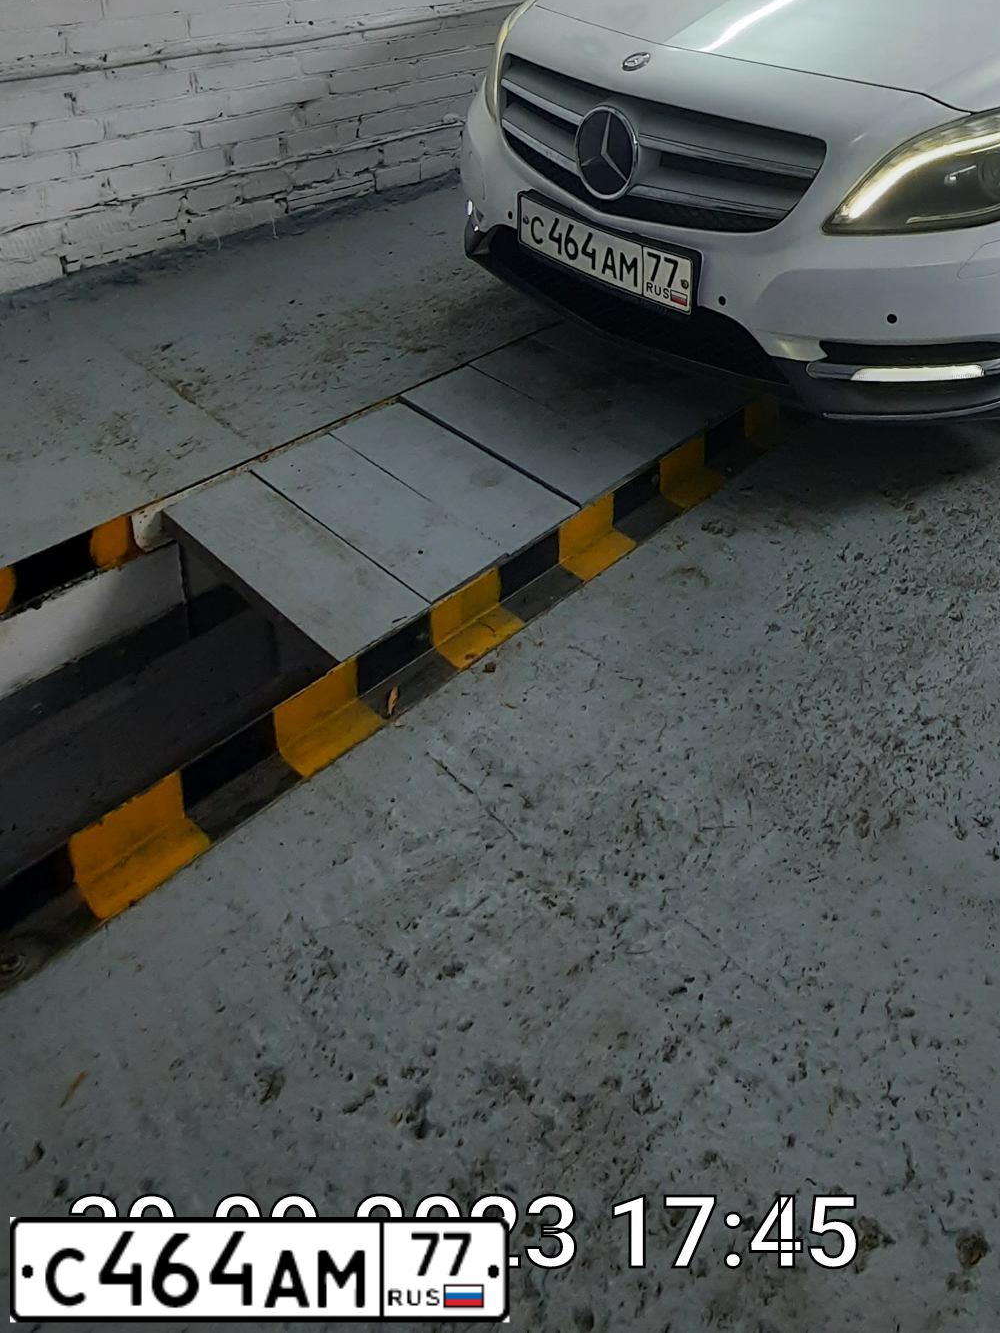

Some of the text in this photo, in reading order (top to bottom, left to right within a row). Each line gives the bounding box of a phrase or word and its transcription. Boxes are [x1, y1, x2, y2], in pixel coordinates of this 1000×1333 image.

[530, 216, 680, 289] С464АМ 77
[646, 280, 671, 300] RUS
